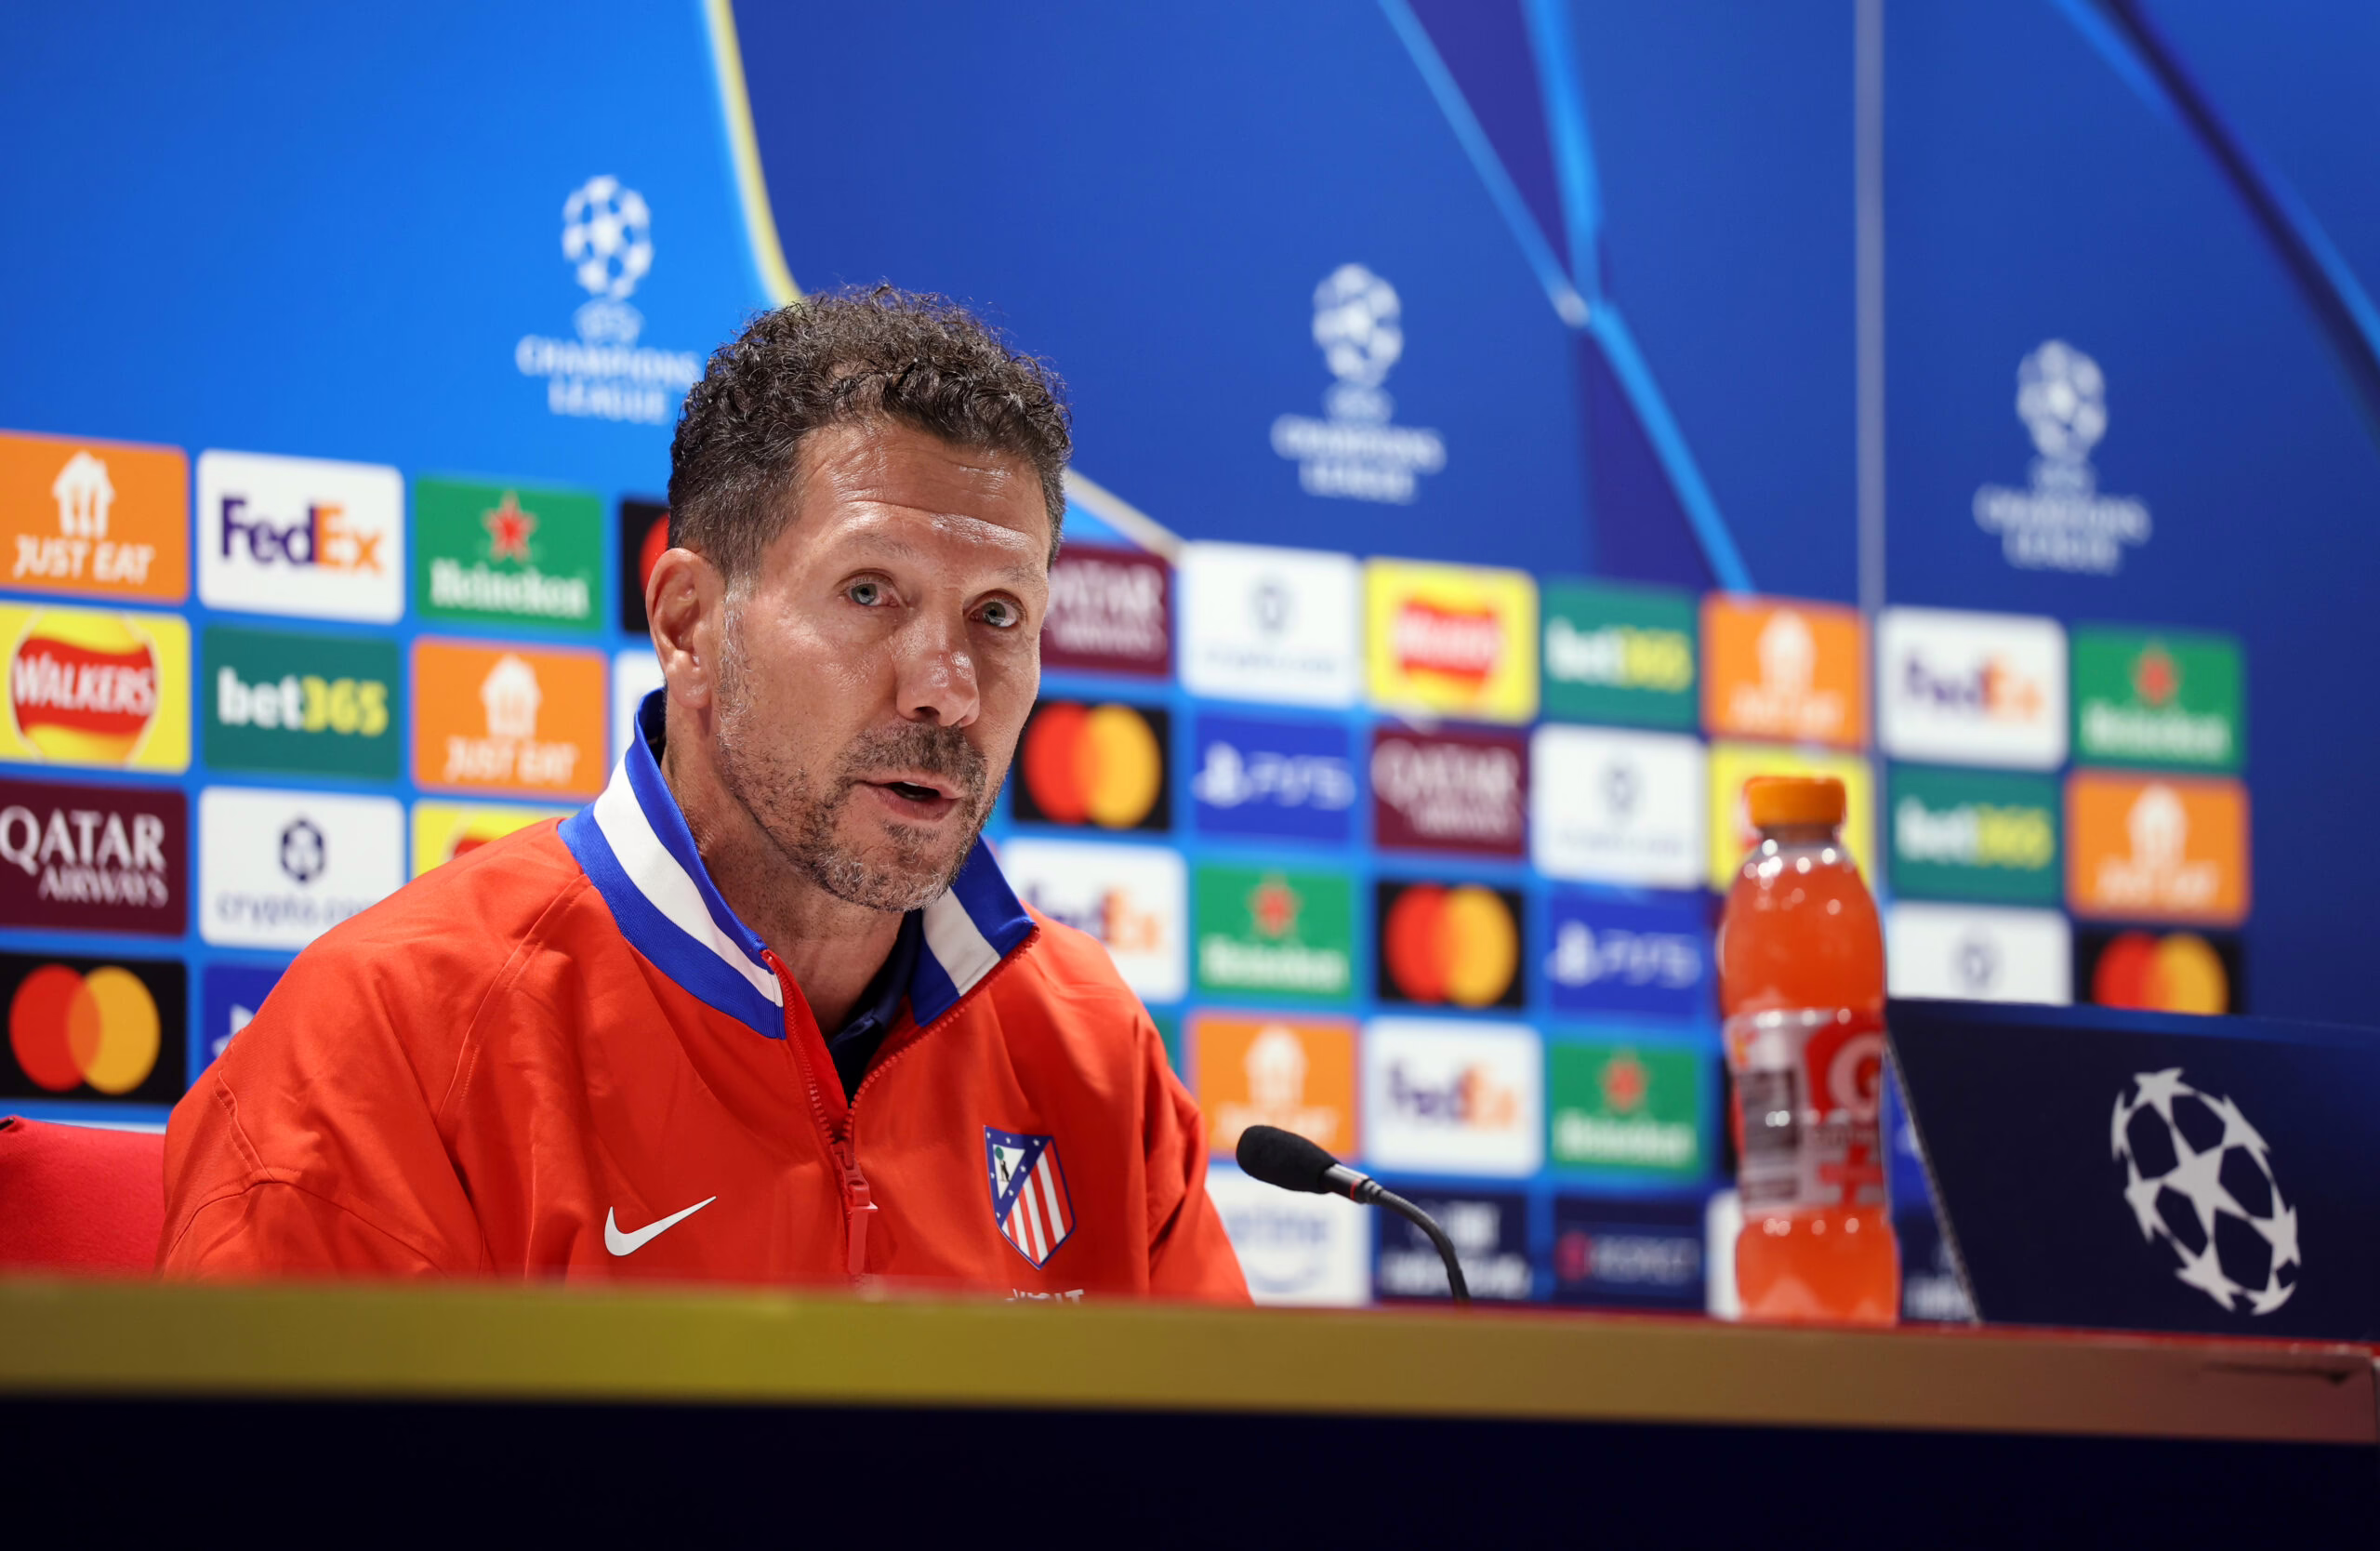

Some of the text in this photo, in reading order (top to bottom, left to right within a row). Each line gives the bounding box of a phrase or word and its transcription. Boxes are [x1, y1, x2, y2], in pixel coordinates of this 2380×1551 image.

[13, 534, 156, 585] JUST EAT
[219, 495, 384, 575] FedEx
[430, 557, 589, 619] Heineken
[14, 651, 157, 718] WALKERS
[218, 666, 389, 736] bet365
[0, 805, 167, 876] QATAR
[38, 865, 169, 908] AIRWAYS
